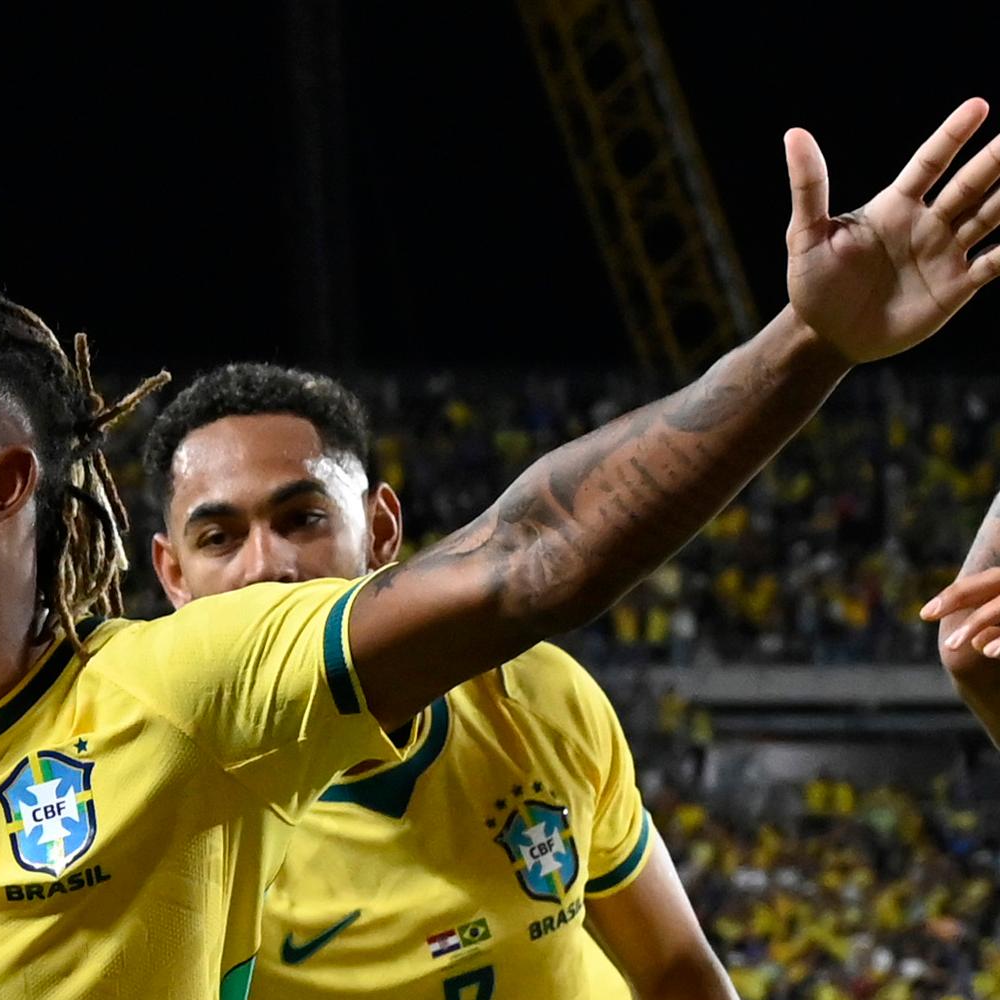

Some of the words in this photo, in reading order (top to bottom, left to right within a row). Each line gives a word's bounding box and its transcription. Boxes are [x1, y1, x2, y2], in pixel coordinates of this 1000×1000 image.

[32, 801, 66, 822] CBF
[529, 838, 555, 859] CBF
[5, 865, 111, 901] BRASIL
